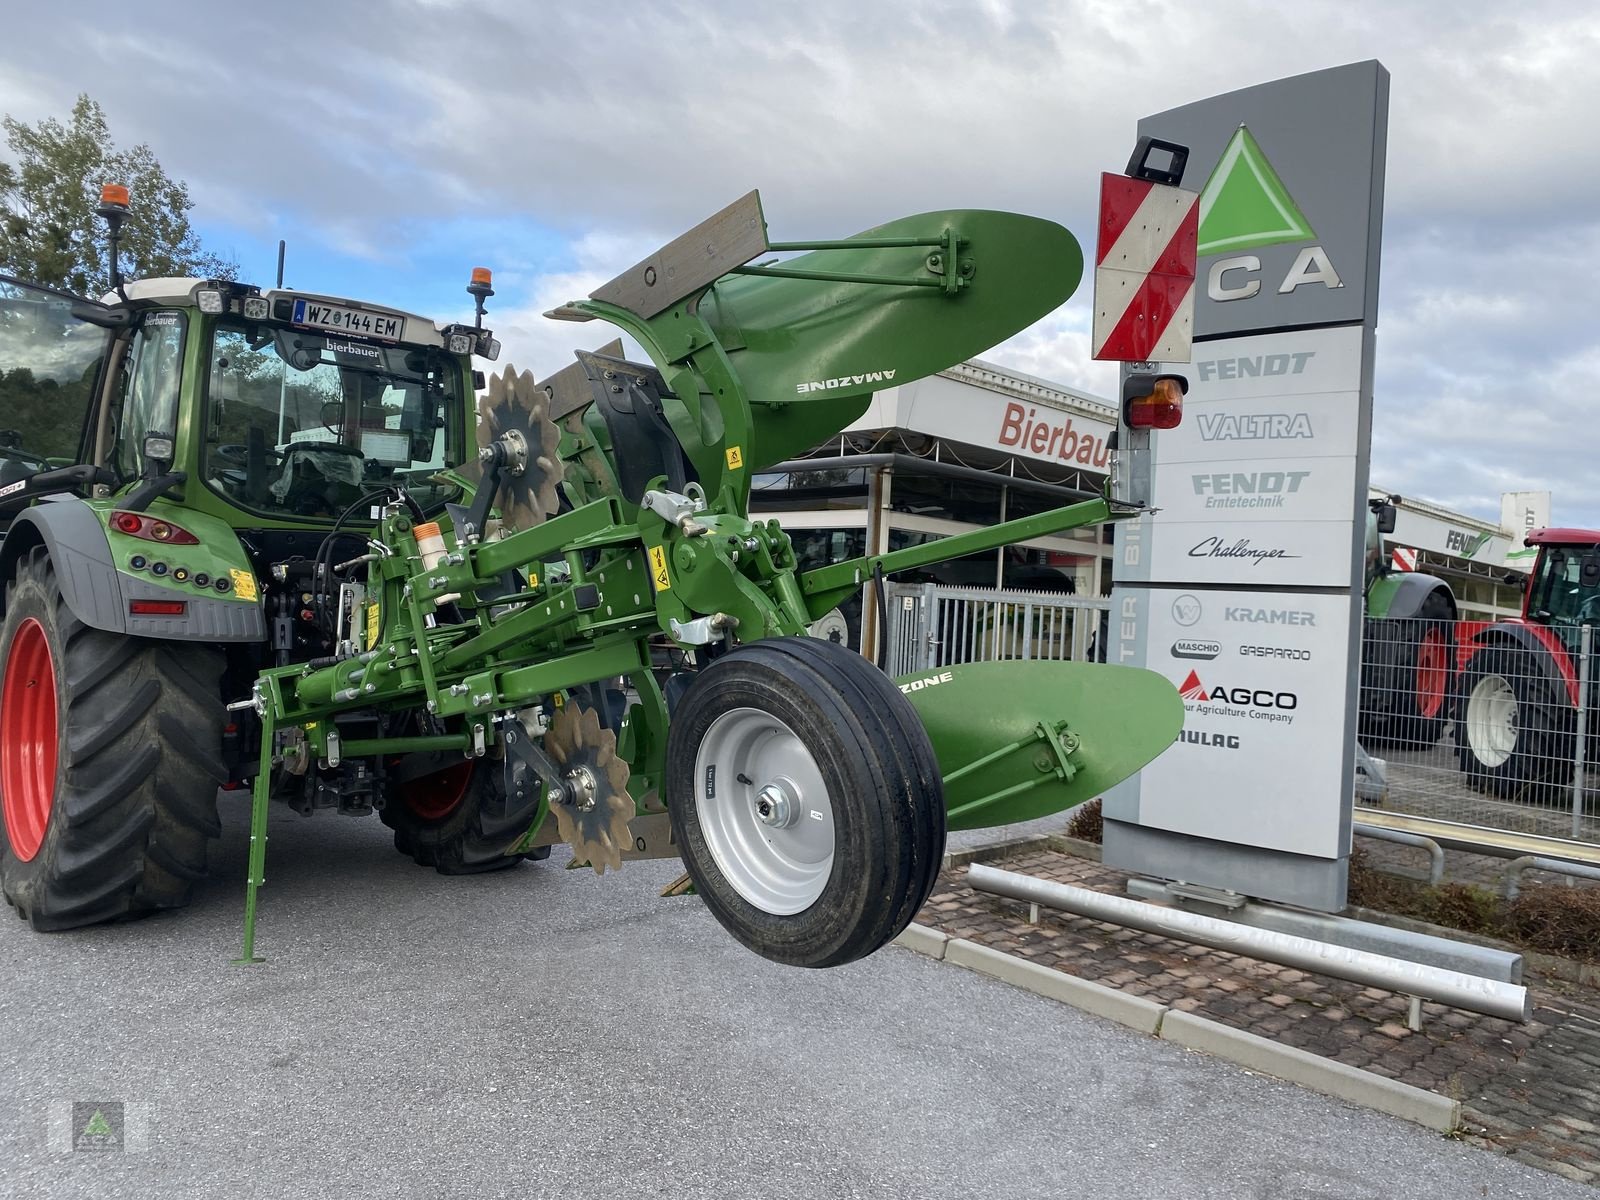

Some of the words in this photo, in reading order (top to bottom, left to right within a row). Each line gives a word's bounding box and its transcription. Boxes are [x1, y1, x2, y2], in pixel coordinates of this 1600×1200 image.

[308, 305, 332, 325] WZ
[344, 312, 371, 332] 144
[374, 317, 397, 336] EM
[326, 338, 380, 358] bierbauer
[1197, 351, 1316, 382] FENDT
[796, 369, 896, 394] AMAZONE
[998, 402, 1109, 468] Bierbau
[1196, 413, 1314, 441] VALTRA
[1191, 471, 1312, 496] FENDT
[1205, 495, 1285, 509] Erntetechnik
[1188, 536, 1303, 566] Challenger
[1224, 606, 1316, 627] KRAMER
[1177, 642, 1220, 653] MASCHIO
[1239, 645, 1311, 661] GASPARDO
[1210, 686, 1298, 710] AGCO
[1196, 704, 1246, 718] Agriculture
[1248, 709, 1294, 725] Company
